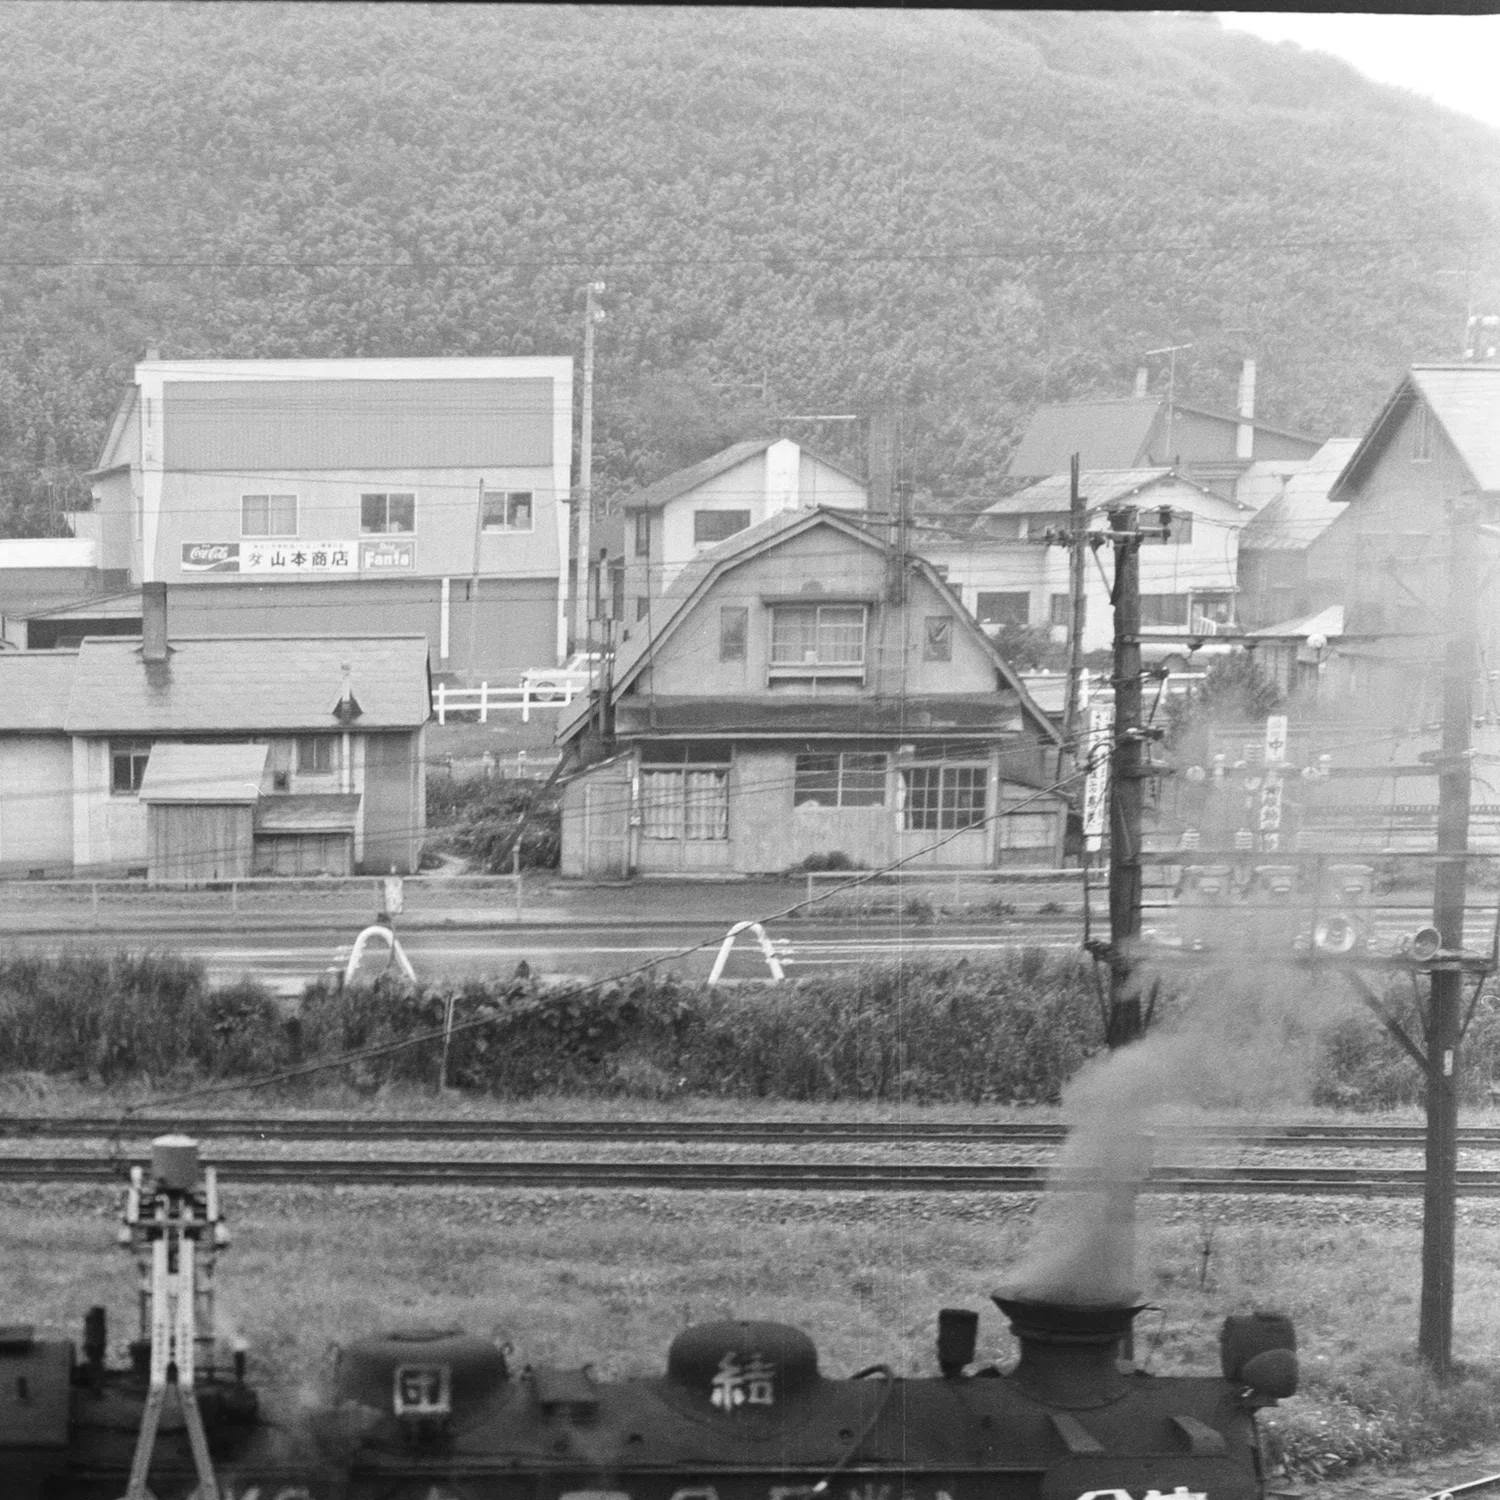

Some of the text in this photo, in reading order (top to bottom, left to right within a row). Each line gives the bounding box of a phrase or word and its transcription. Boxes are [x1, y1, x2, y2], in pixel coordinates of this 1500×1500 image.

[271, 550, 349, 567] 山本商店
[365, 551, 409, 568] Fanta
